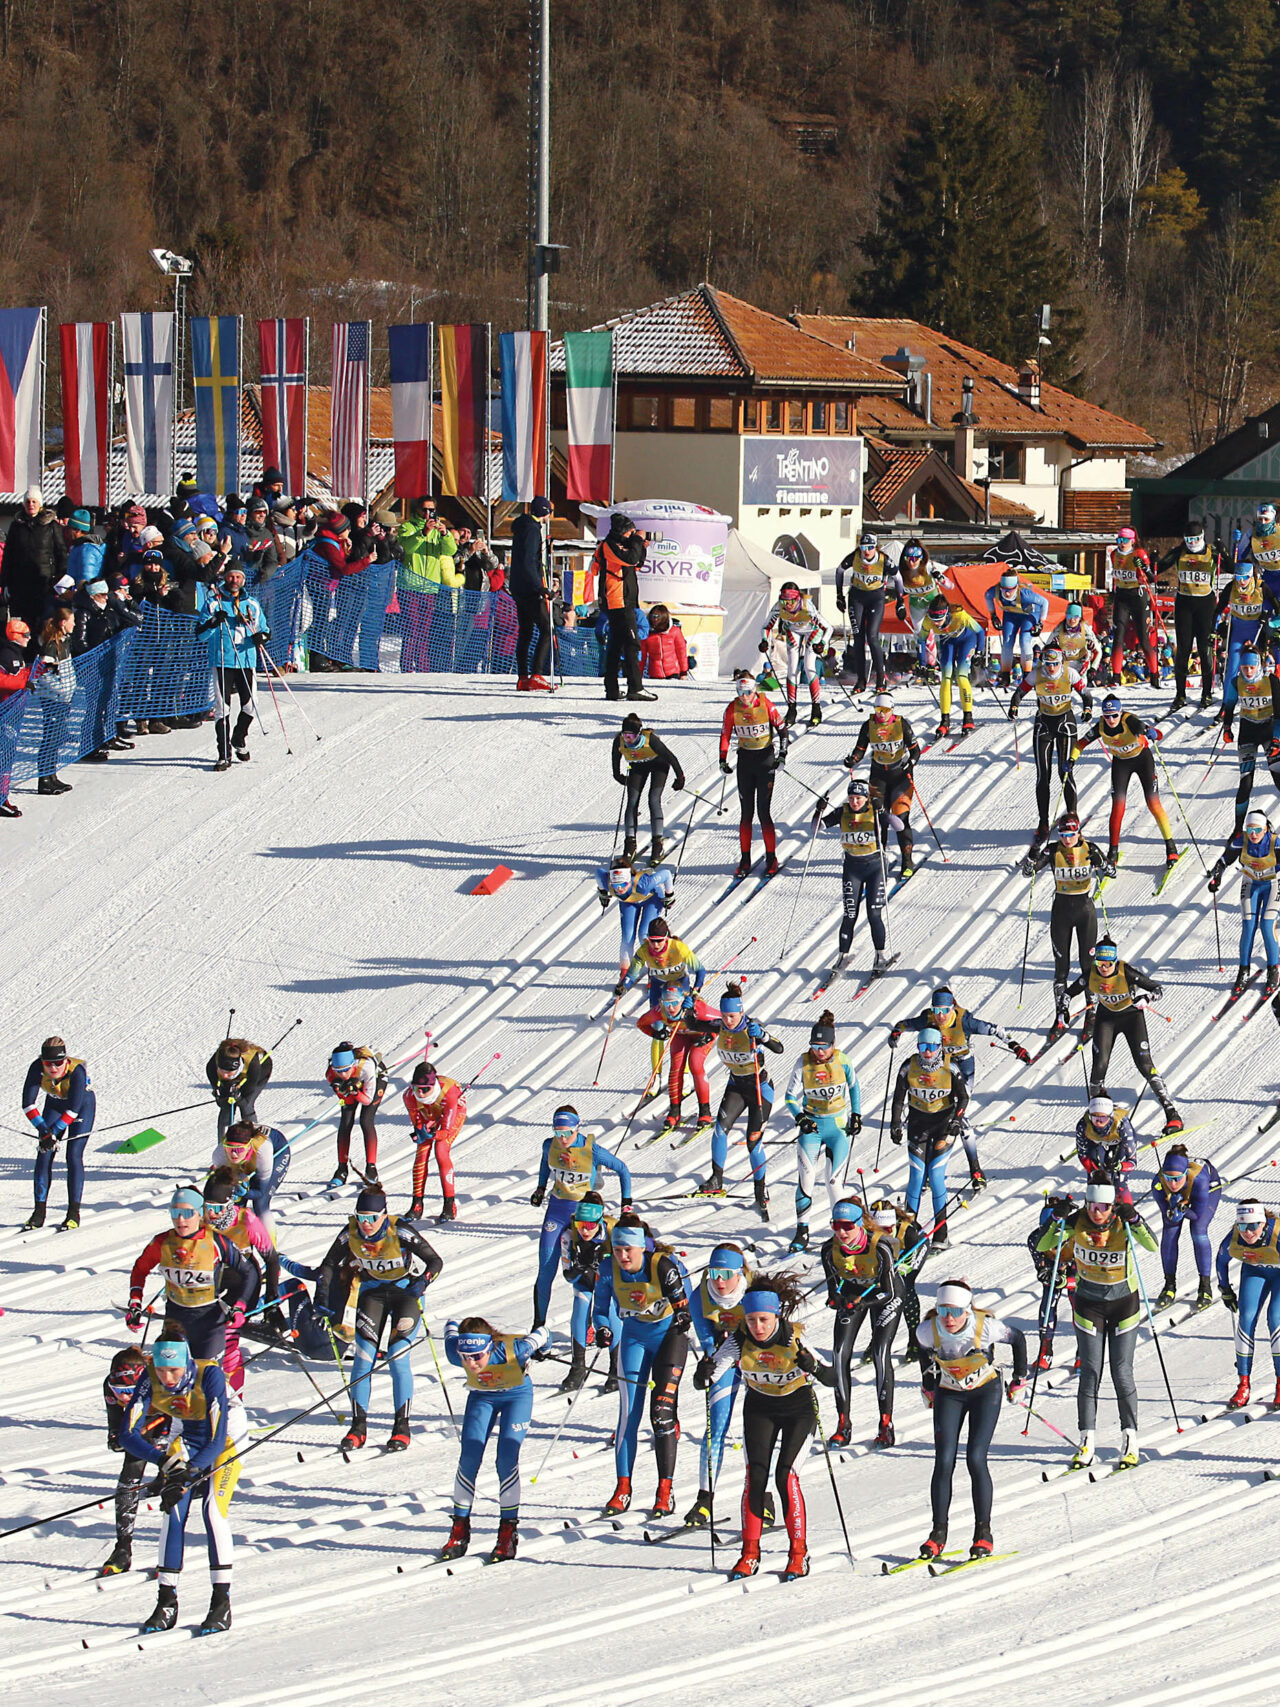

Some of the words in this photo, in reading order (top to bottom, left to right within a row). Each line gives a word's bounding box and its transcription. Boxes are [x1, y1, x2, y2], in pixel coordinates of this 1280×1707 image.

[776, 453, 830, 482] TRENTINO
[776, 489, 829, 504] fiemme
[657, 543, 678, 551] mila
[639, 560, 693, 576] SKYR
[1183, 571, 1206, 582] 1183
[1242, 697, 1268, 708] 1218
[740, 724, 765, 736] 1153
[844, 831, 870, 842] 1169
[1060, 867, 1088, 879] 1188
[1081, 1249, 1119, 1264] 1098
[165, 1268, 206, 1284] 1126
[750, 1371, 797, 1386] 1178
